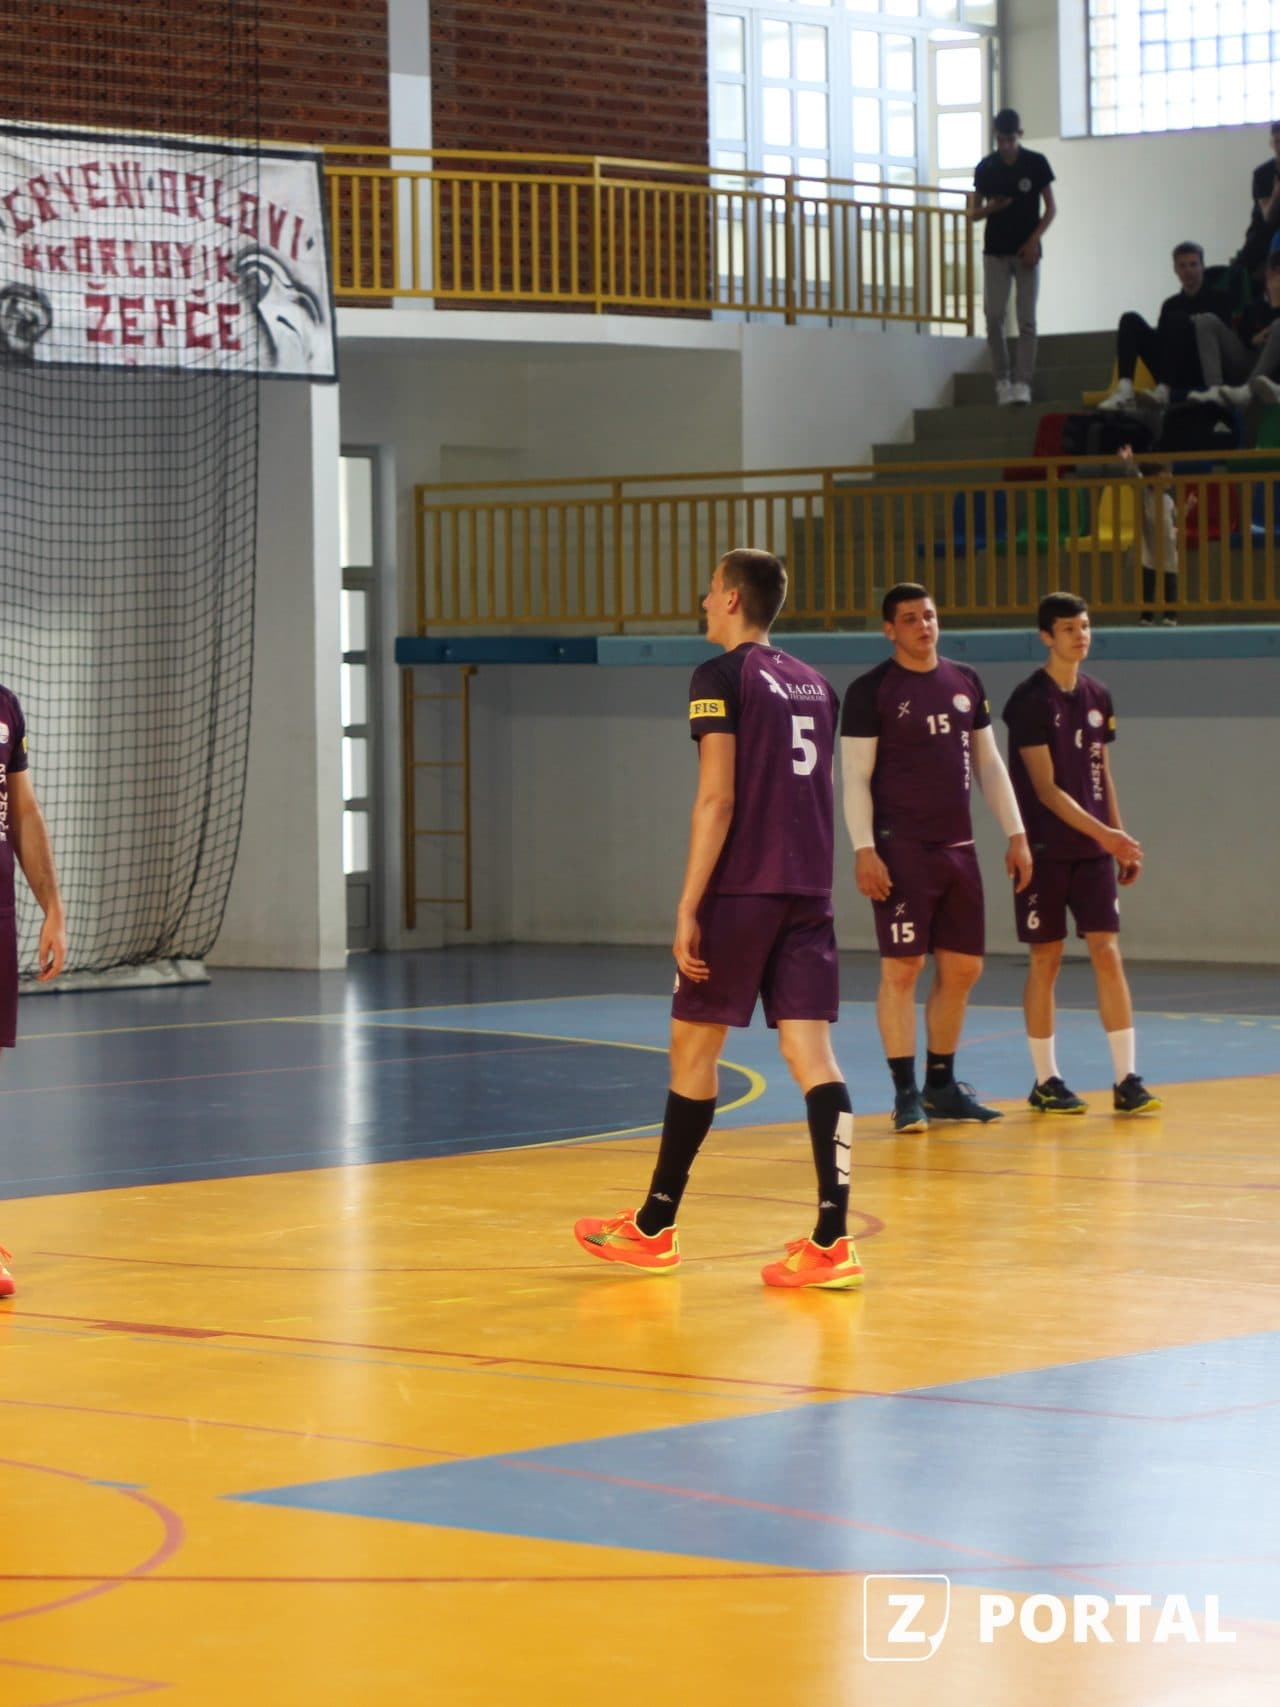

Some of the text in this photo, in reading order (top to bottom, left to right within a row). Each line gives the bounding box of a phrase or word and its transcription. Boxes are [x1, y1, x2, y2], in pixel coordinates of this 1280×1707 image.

[2, 161, 146, 238] CRVENI
[694, 702, 719, 714] FIS
[926, 713, 951, 735] 15
[791, 714, 818, 776] 5
[1026, 910, 1040, 930] 6
[890, 922, 916, 944] 15
